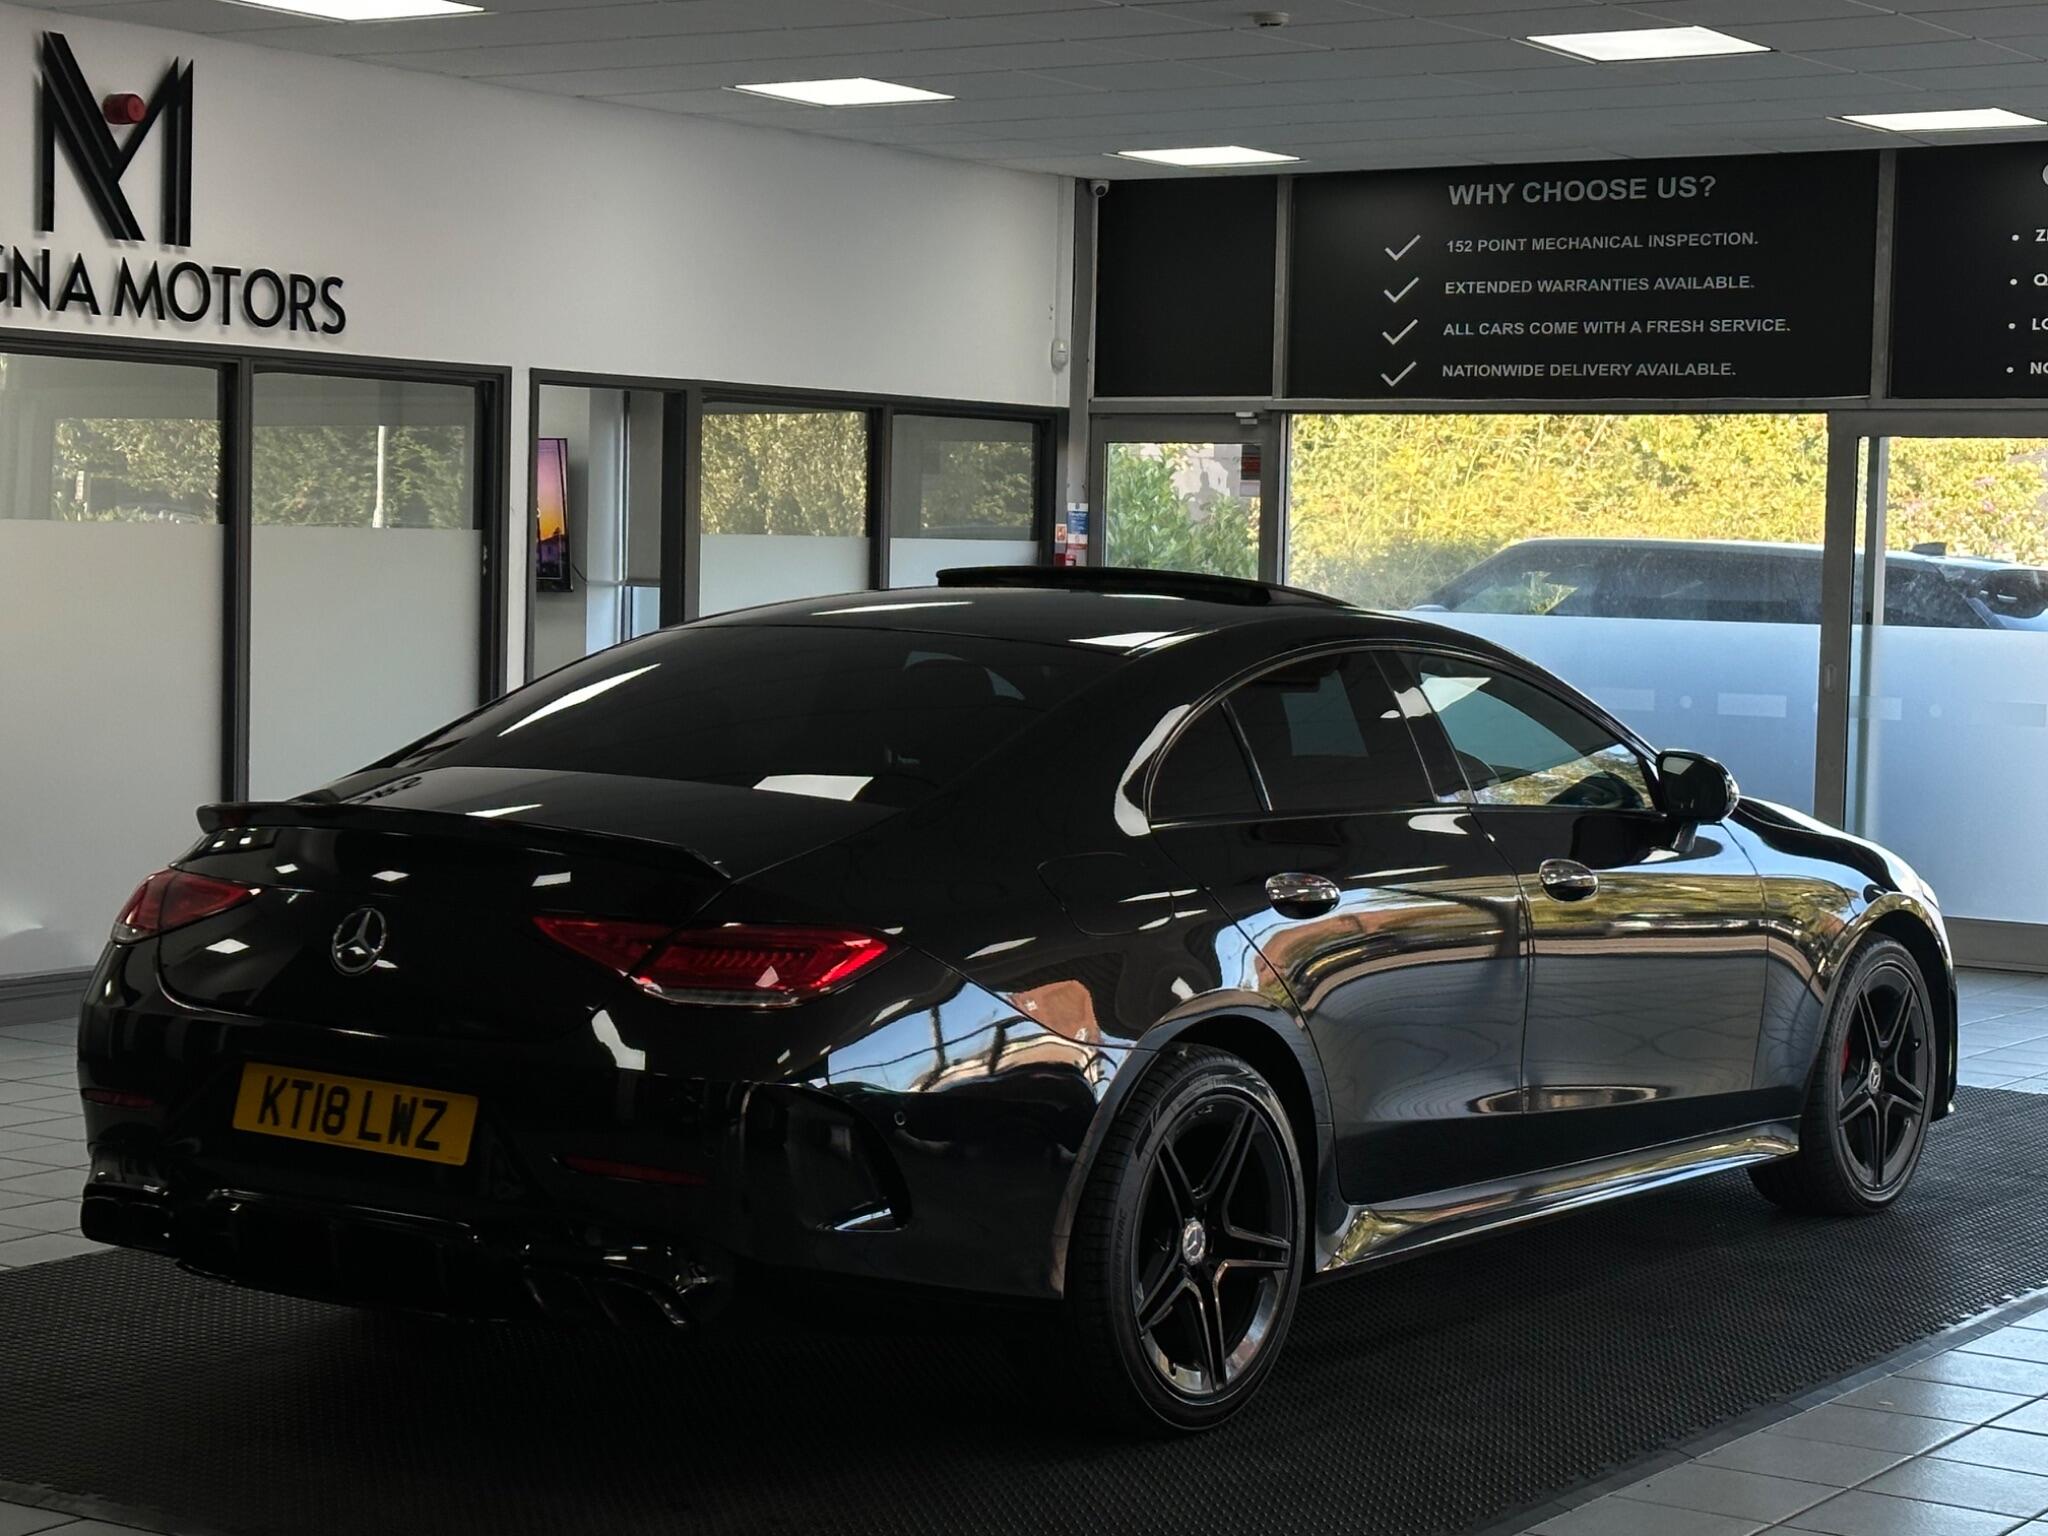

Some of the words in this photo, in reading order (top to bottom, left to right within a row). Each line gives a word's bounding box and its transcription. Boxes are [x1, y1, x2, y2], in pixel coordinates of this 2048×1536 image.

[1448, 182, 1515, 206] WHY
[1522, 178, 1648, 203] CHOOSE
[1657, 175, 1717, 199] US?
[1446, 240, 1473, 253] 152
[1477, 238, 1527, 252] POINT
[1531, 235, 1644, 251] MECHANICAL
[1648, 232, 1759, 248] INSPECTION.
[113, 256, 346, 335] MOTORS
[1444, 280, 1533, 295] EXTENDED
[1537, 278, 1650, 293] WARRANTIES
[1653, 275, 1755, 290] AVAILABLE.
[1443, 323, 1474, 336] ALL
[1478, 322, 1525, 336] CARS
[1529, 321, 1579, 335] COME
[1583, 320, 1626, 334] WITH
[1630, 321, 1643, 334] A
[1646, 319, 1705, 334] FRESH
[1709, 318, 1791, 333] SERVICE.
[1442, 363, 1545, 378] NATIONWIDE
[1549, 362, 1633, 377] DELIVERY
[1635, 362, 1736, 377] AVAILABLE.
[257, 1075, 350, 1136] KT18
[356, 1090, 449, 1151] LWZ
